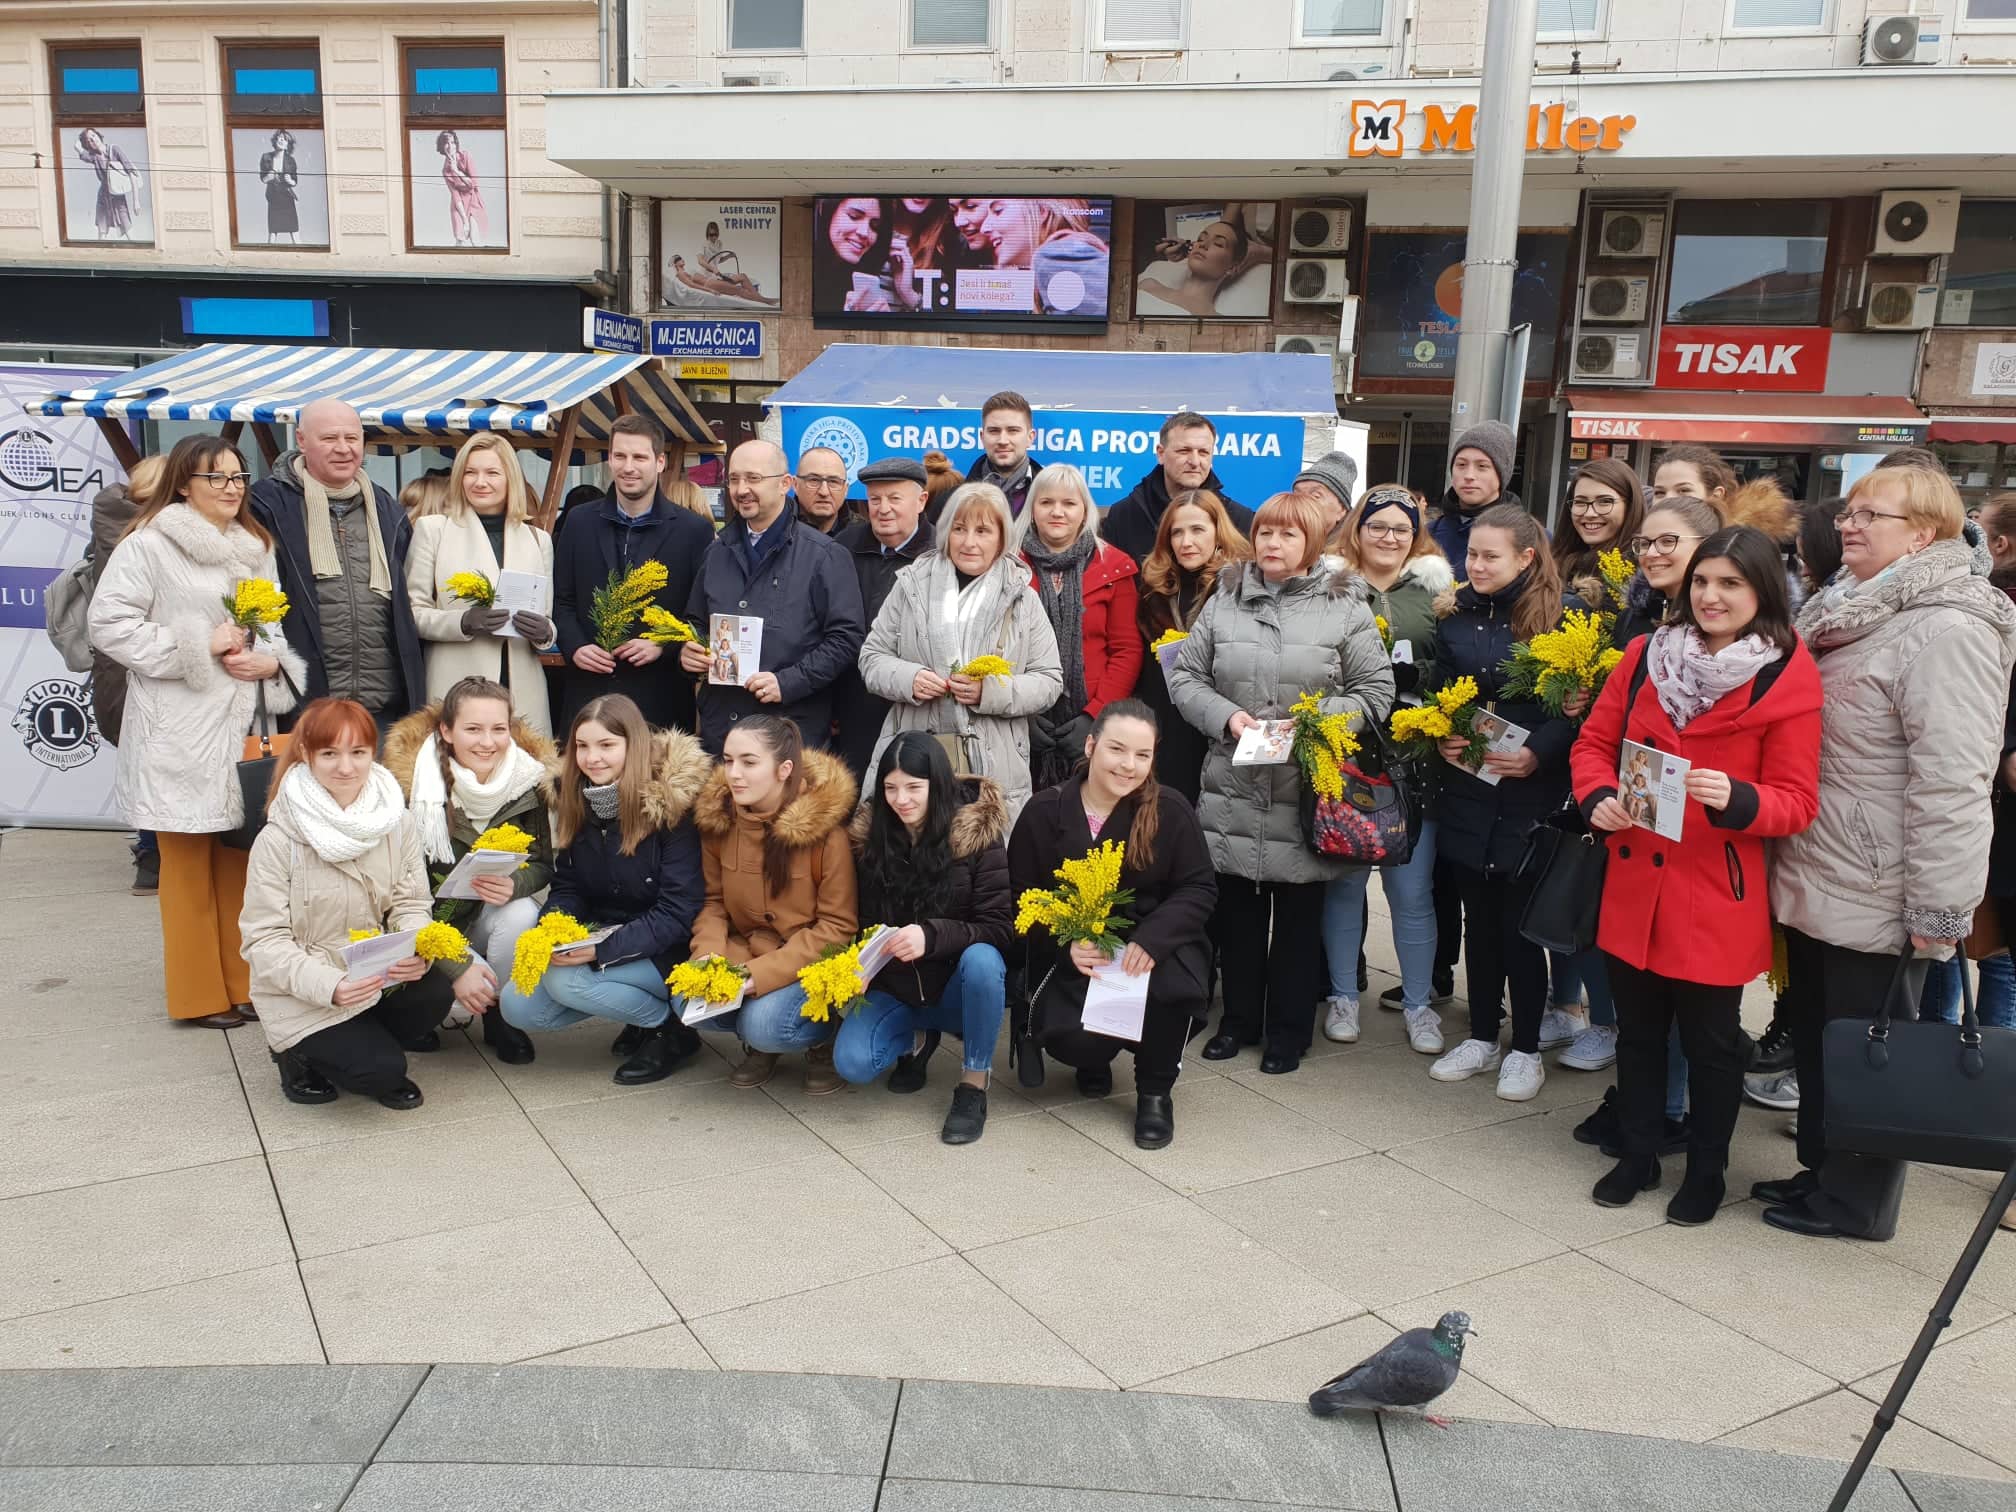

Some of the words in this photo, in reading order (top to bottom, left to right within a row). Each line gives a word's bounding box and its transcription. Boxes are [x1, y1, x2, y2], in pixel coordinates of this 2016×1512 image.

[1419, 104, 1636, 152] Mller
[719, 206, 743, 214] LASER
[745, 206, 777, 214] CENTAR
[723, 218, 772, 229] TRINITY
[595, 317, 641, 343] MJENJAČNICA
[657, 324, 756, 346] MJENJAČNICA
[672, 347, 713, 355] EXCHANGE
[714, 347, 742, 355] OFFICE
[1675, 343, 1804, 374] TISAK
[1579, 420, 1642, 437] TISAK
[883, 425, 984, 450] GRADS
[1026, 428, 1084, 452] IGA
[1092, 429, 1161, 454] PROT
[60, 512, 87, 521] CLUB
[32, 683, 87, 703] LIONS
[50, 708, 76, 739] L
[35, 745, 91, 764] INTERNATIONAL
